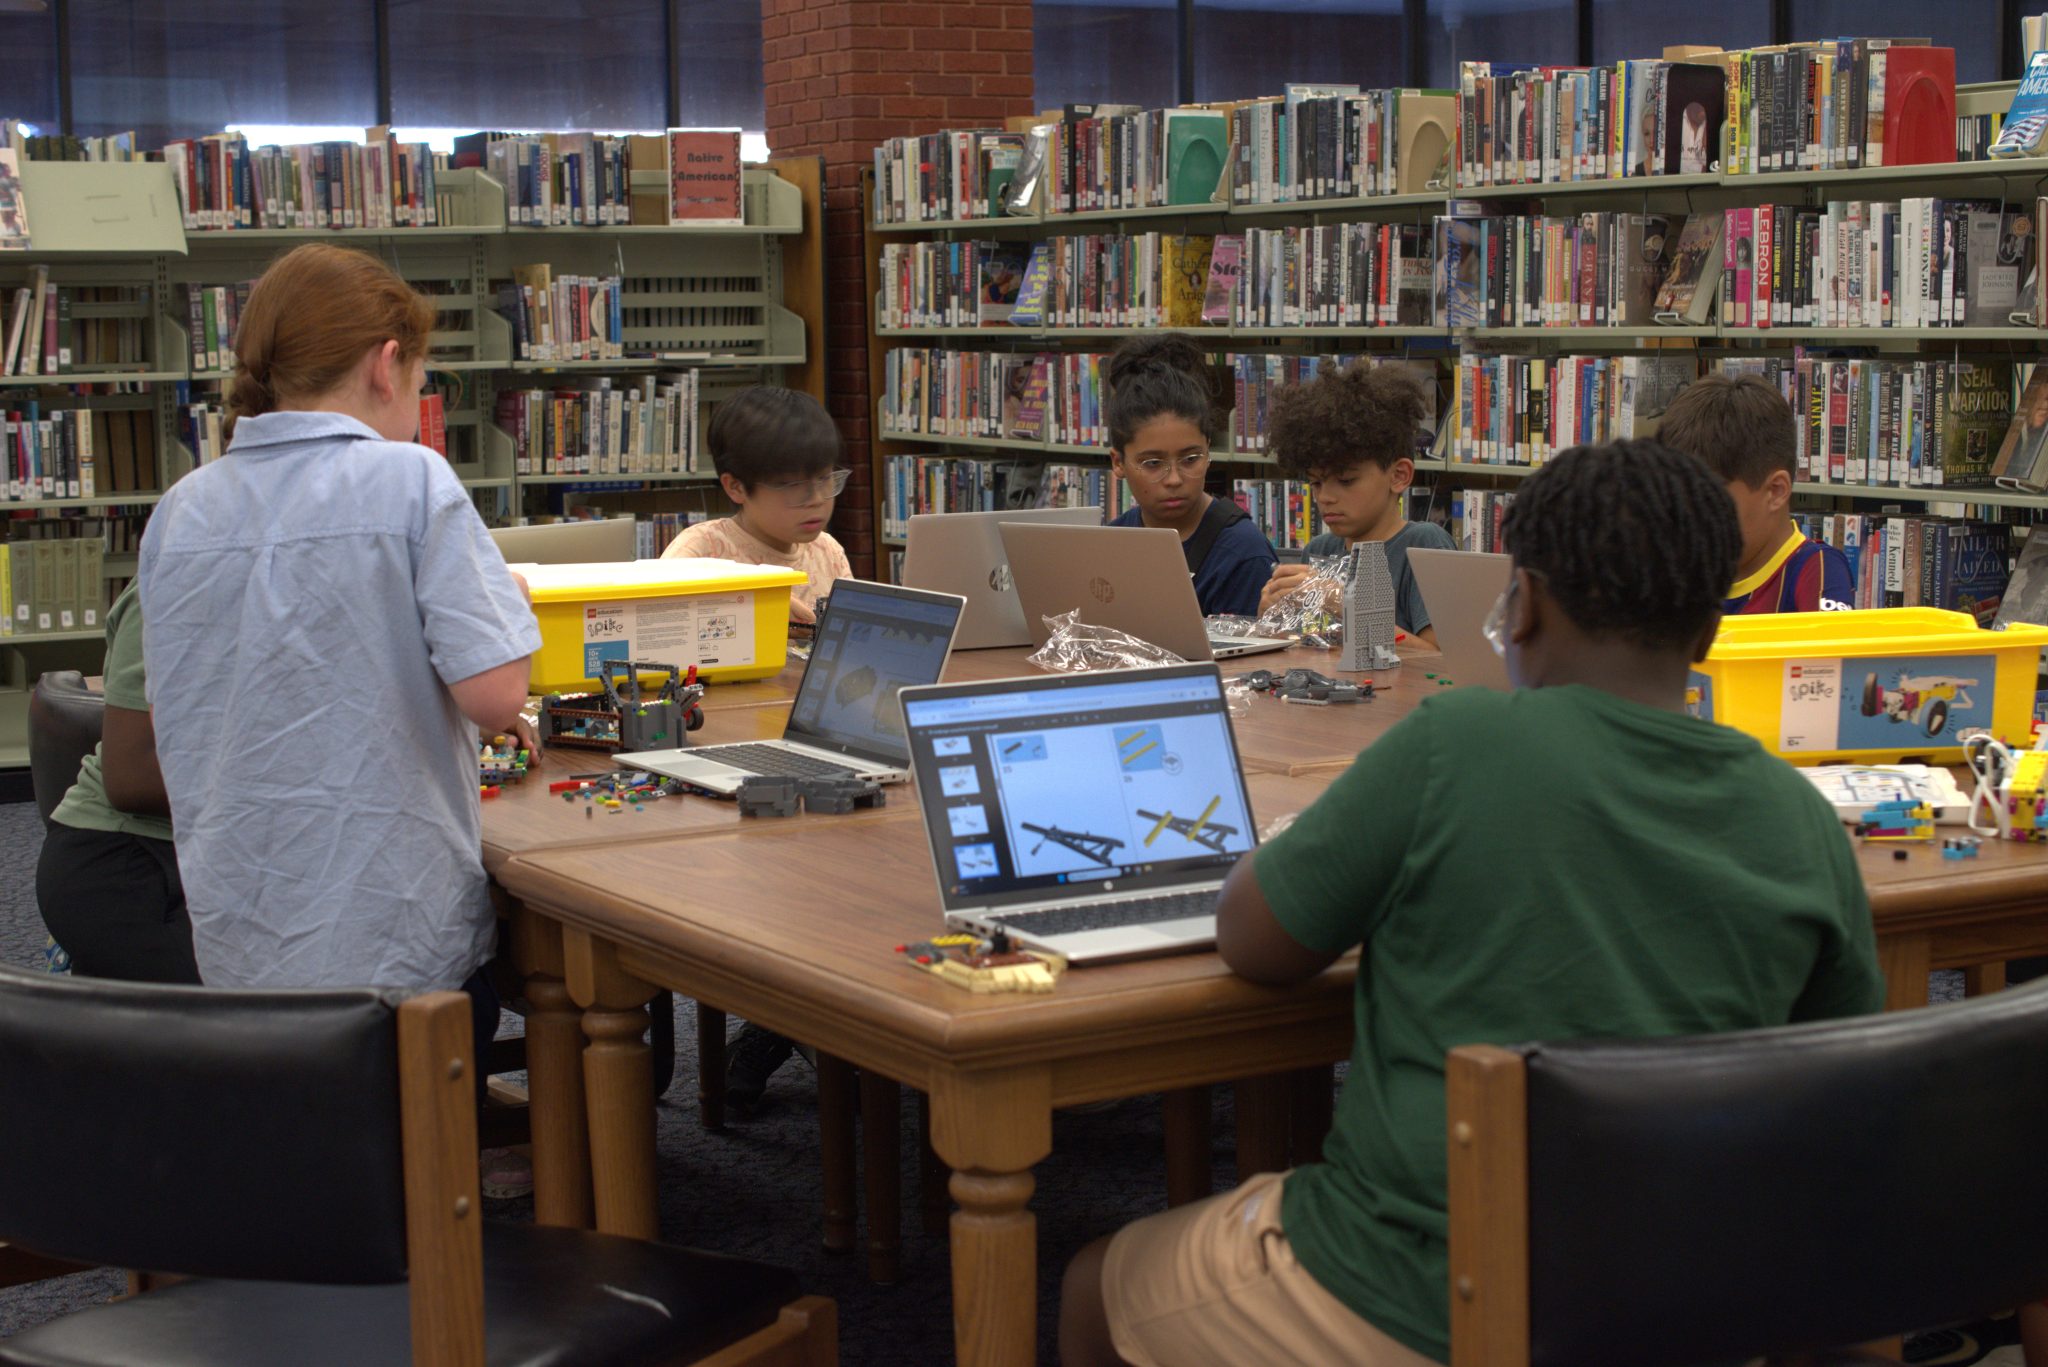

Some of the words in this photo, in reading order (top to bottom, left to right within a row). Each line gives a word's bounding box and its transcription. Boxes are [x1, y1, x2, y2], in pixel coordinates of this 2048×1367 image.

[1773, 76, 1784, 147] HUGHES
[687, 153, 724, 162] Native
[679, 172, 734, 181] American
[1759, 208, 1769, 285] LEBRON
[1921, 228, 1929, 272] ELTON
[1213, 262, 1240, 275] Ste
[1332, 242, 1340, 296] EDISON
[1881, 371, 1890, 385] THE
[1964, 368, 1995, 387] SEAL
[1811, 387, 1821, 426] JANIS
[1880, 386, 1890, 414] HIDDEN
[1892, 397, 1900, 409] THE
[1949, 391, 2009, 412] WARRIOR
[1880, 415, 1889, 431] NAZI
[1892, 412, 1900, 434] SAINT
[1934, 392, 1942, 434] WARRIOR
[1946, 464, 1975, 474] THOMAS
[1926, 527, 1935, 552] ROSE
[1951, 536, 2004, 552] JAILER
[1888, 546, 1900, 588] Kennedy
[1923, 555, 1933, 600] KENNEDY
[588, 618, 623, 637] spike
[1790, 680, 1833, 701] spike
